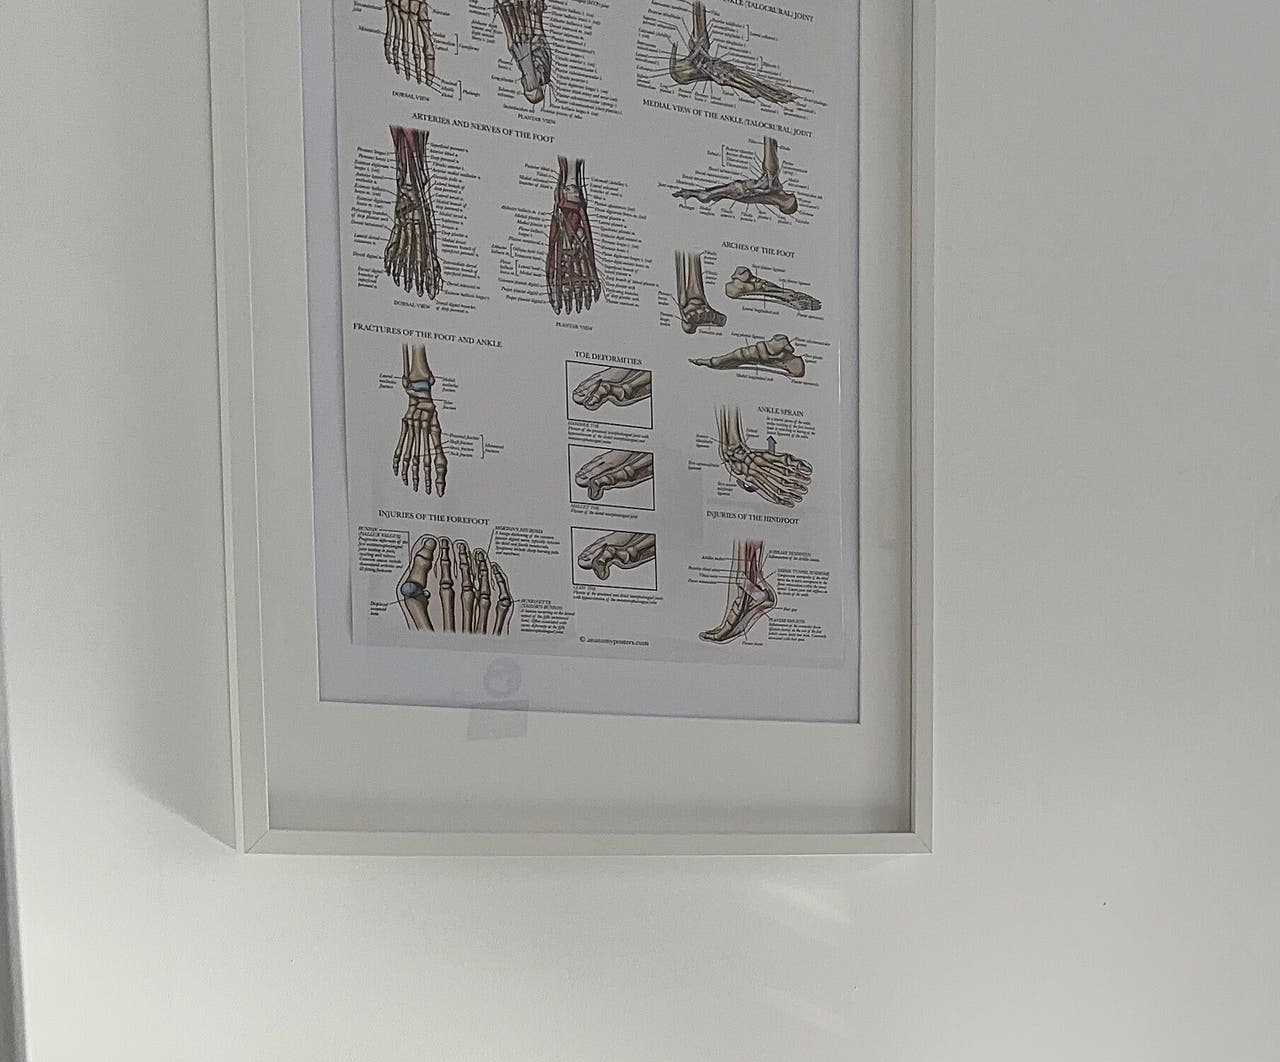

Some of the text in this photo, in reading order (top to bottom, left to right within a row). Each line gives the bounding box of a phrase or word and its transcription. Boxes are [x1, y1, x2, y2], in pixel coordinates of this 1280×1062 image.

[793, 12, 814, 22] JOINT
[642, 98, 671, 111] MEDIAL
[672, 104, 691, 114] VIEW
[692, 108, 702, 116] OF
[703, 110, 718, 120] THE
[720, 113, 743, 124] ANKLE
[793, 128, 813, 138] JOINT
[411, 112, 555, 144] ARTERIES AND NERVES OF THE FOOT
[721, 240, 796, 258] ARCHES OF THE FOOT
[352, 322, 503, 348] FRACTURES OF THE FOOT AND ANKLE
[575, 351, 642, 365] TOE DEFORMITIES
[757, 406, 780, 415] ANKLE
[378, 509, 490, 525] INJURIES OF THE FOREFOOT
[706, 510, 736, 520] INJURIES
[748, 514, 762, 522] THE
[763, 515, 799, 525] HINDFOOT
